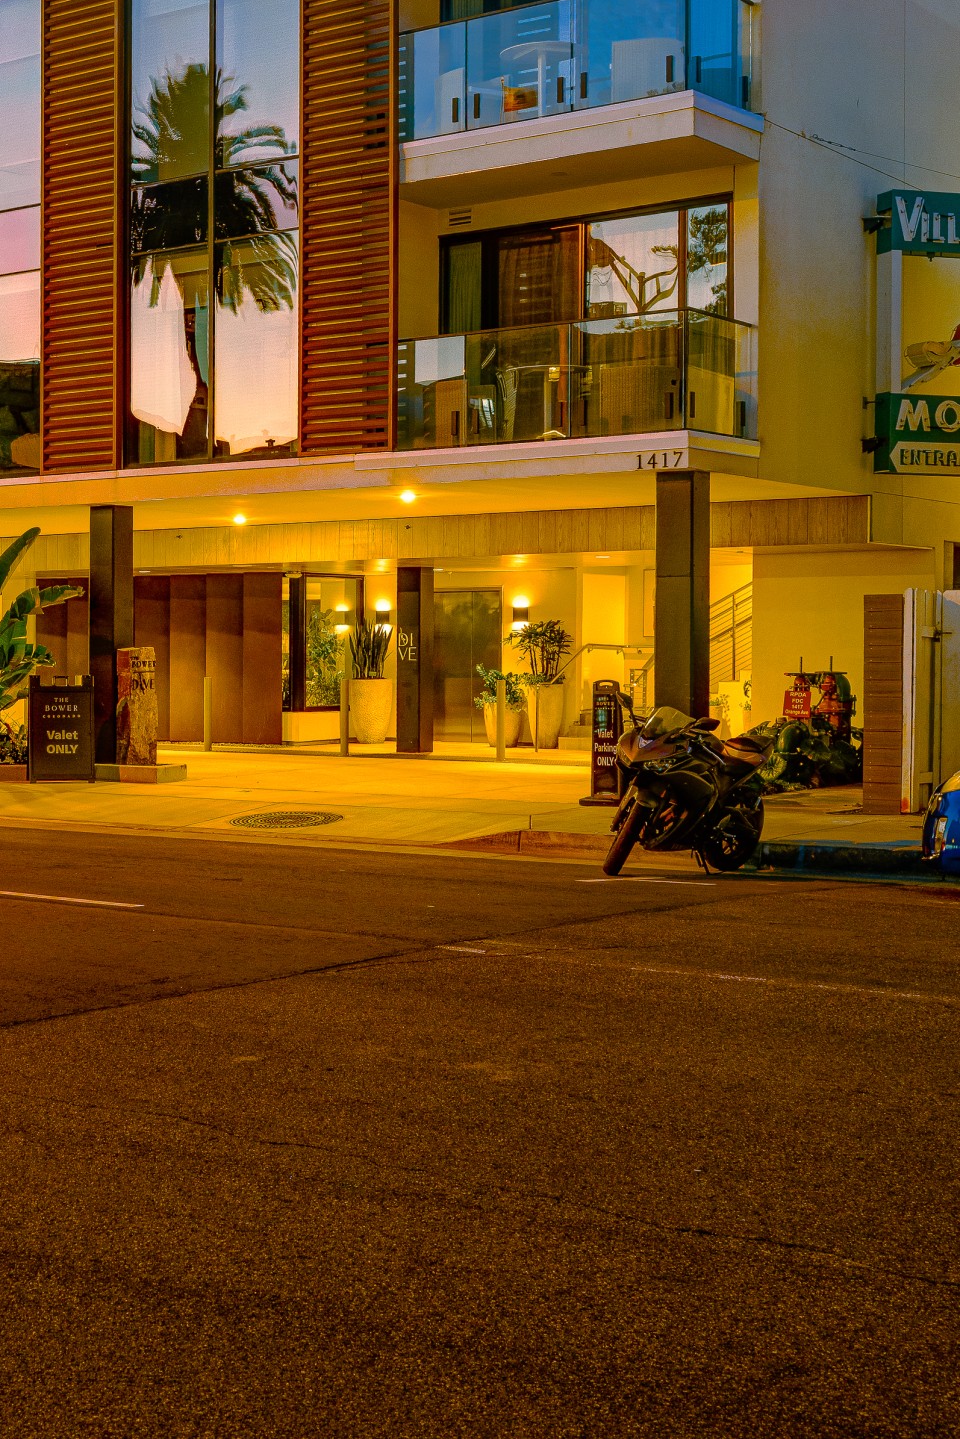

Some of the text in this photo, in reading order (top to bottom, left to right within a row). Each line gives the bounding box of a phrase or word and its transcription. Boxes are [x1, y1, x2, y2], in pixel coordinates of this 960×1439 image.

[636, 451, 683, 470] 1417
[45, 704, 78, 712] BOWER
[46, 730, 79, 740] Valet
[597, 728, 614, 739] Valet
[46, 744, 79, 754] ONLY
[594, 742, 618, 755] Parking
[596, 756, 615, 766] ONLY
